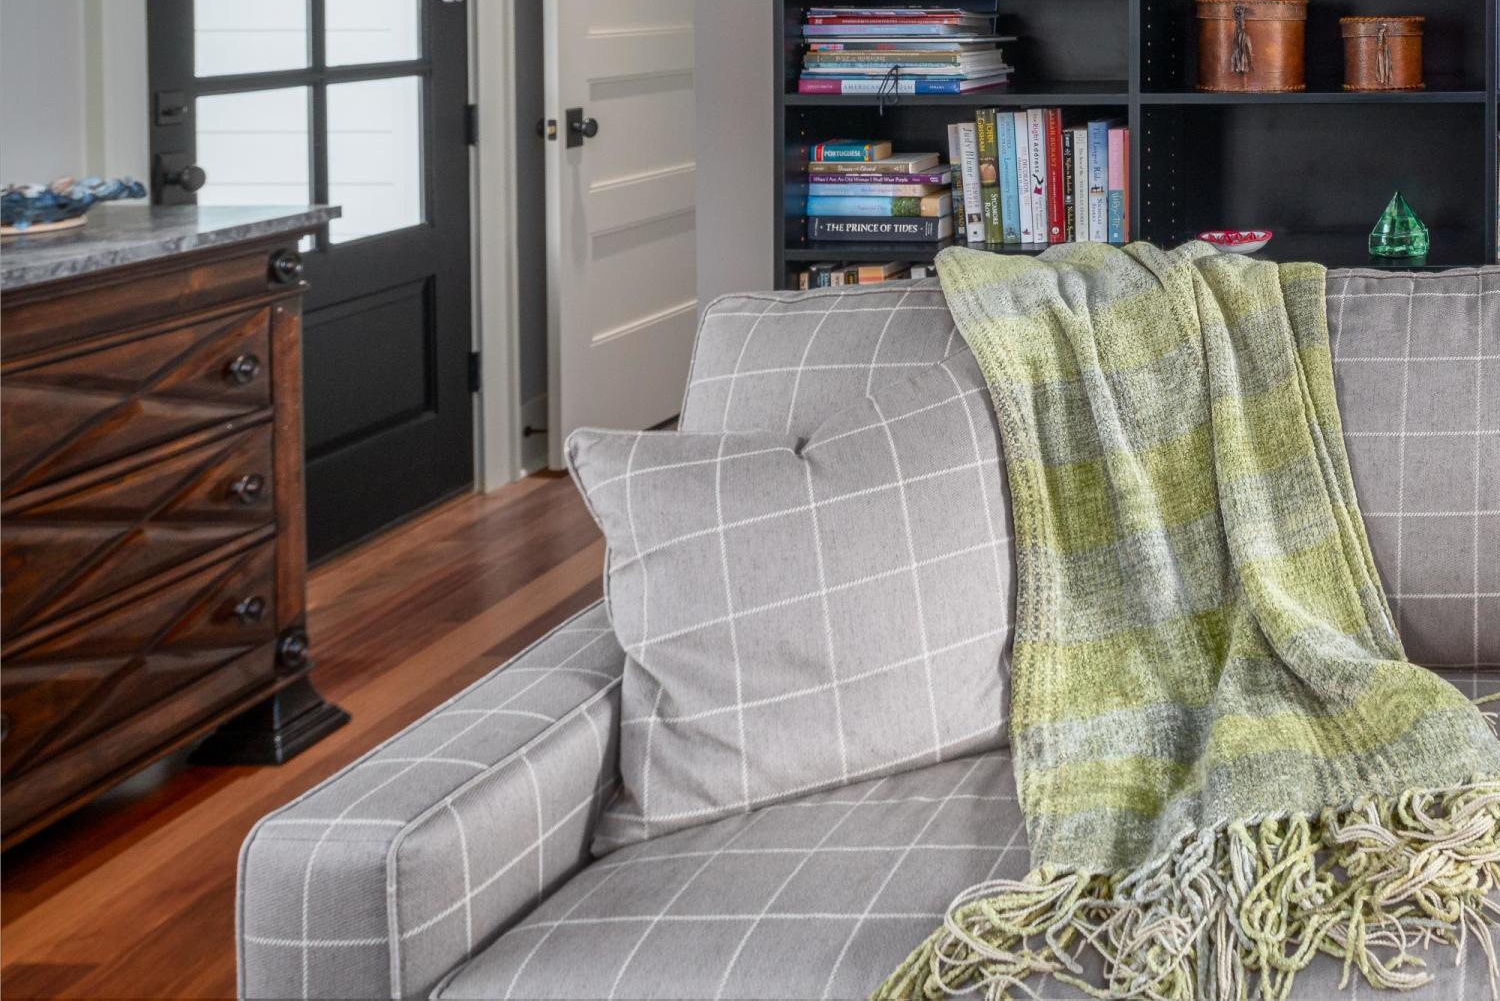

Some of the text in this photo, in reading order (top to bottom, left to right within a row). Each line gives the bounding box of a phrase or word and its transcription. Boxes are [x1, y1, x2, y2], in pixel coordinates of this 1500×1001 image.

[963, 128, 976, 178] Judy Blume
[1093, 167, 1102, 181] Ride
[826, 223, 918, 233] THE PRINCE OF TIDES
